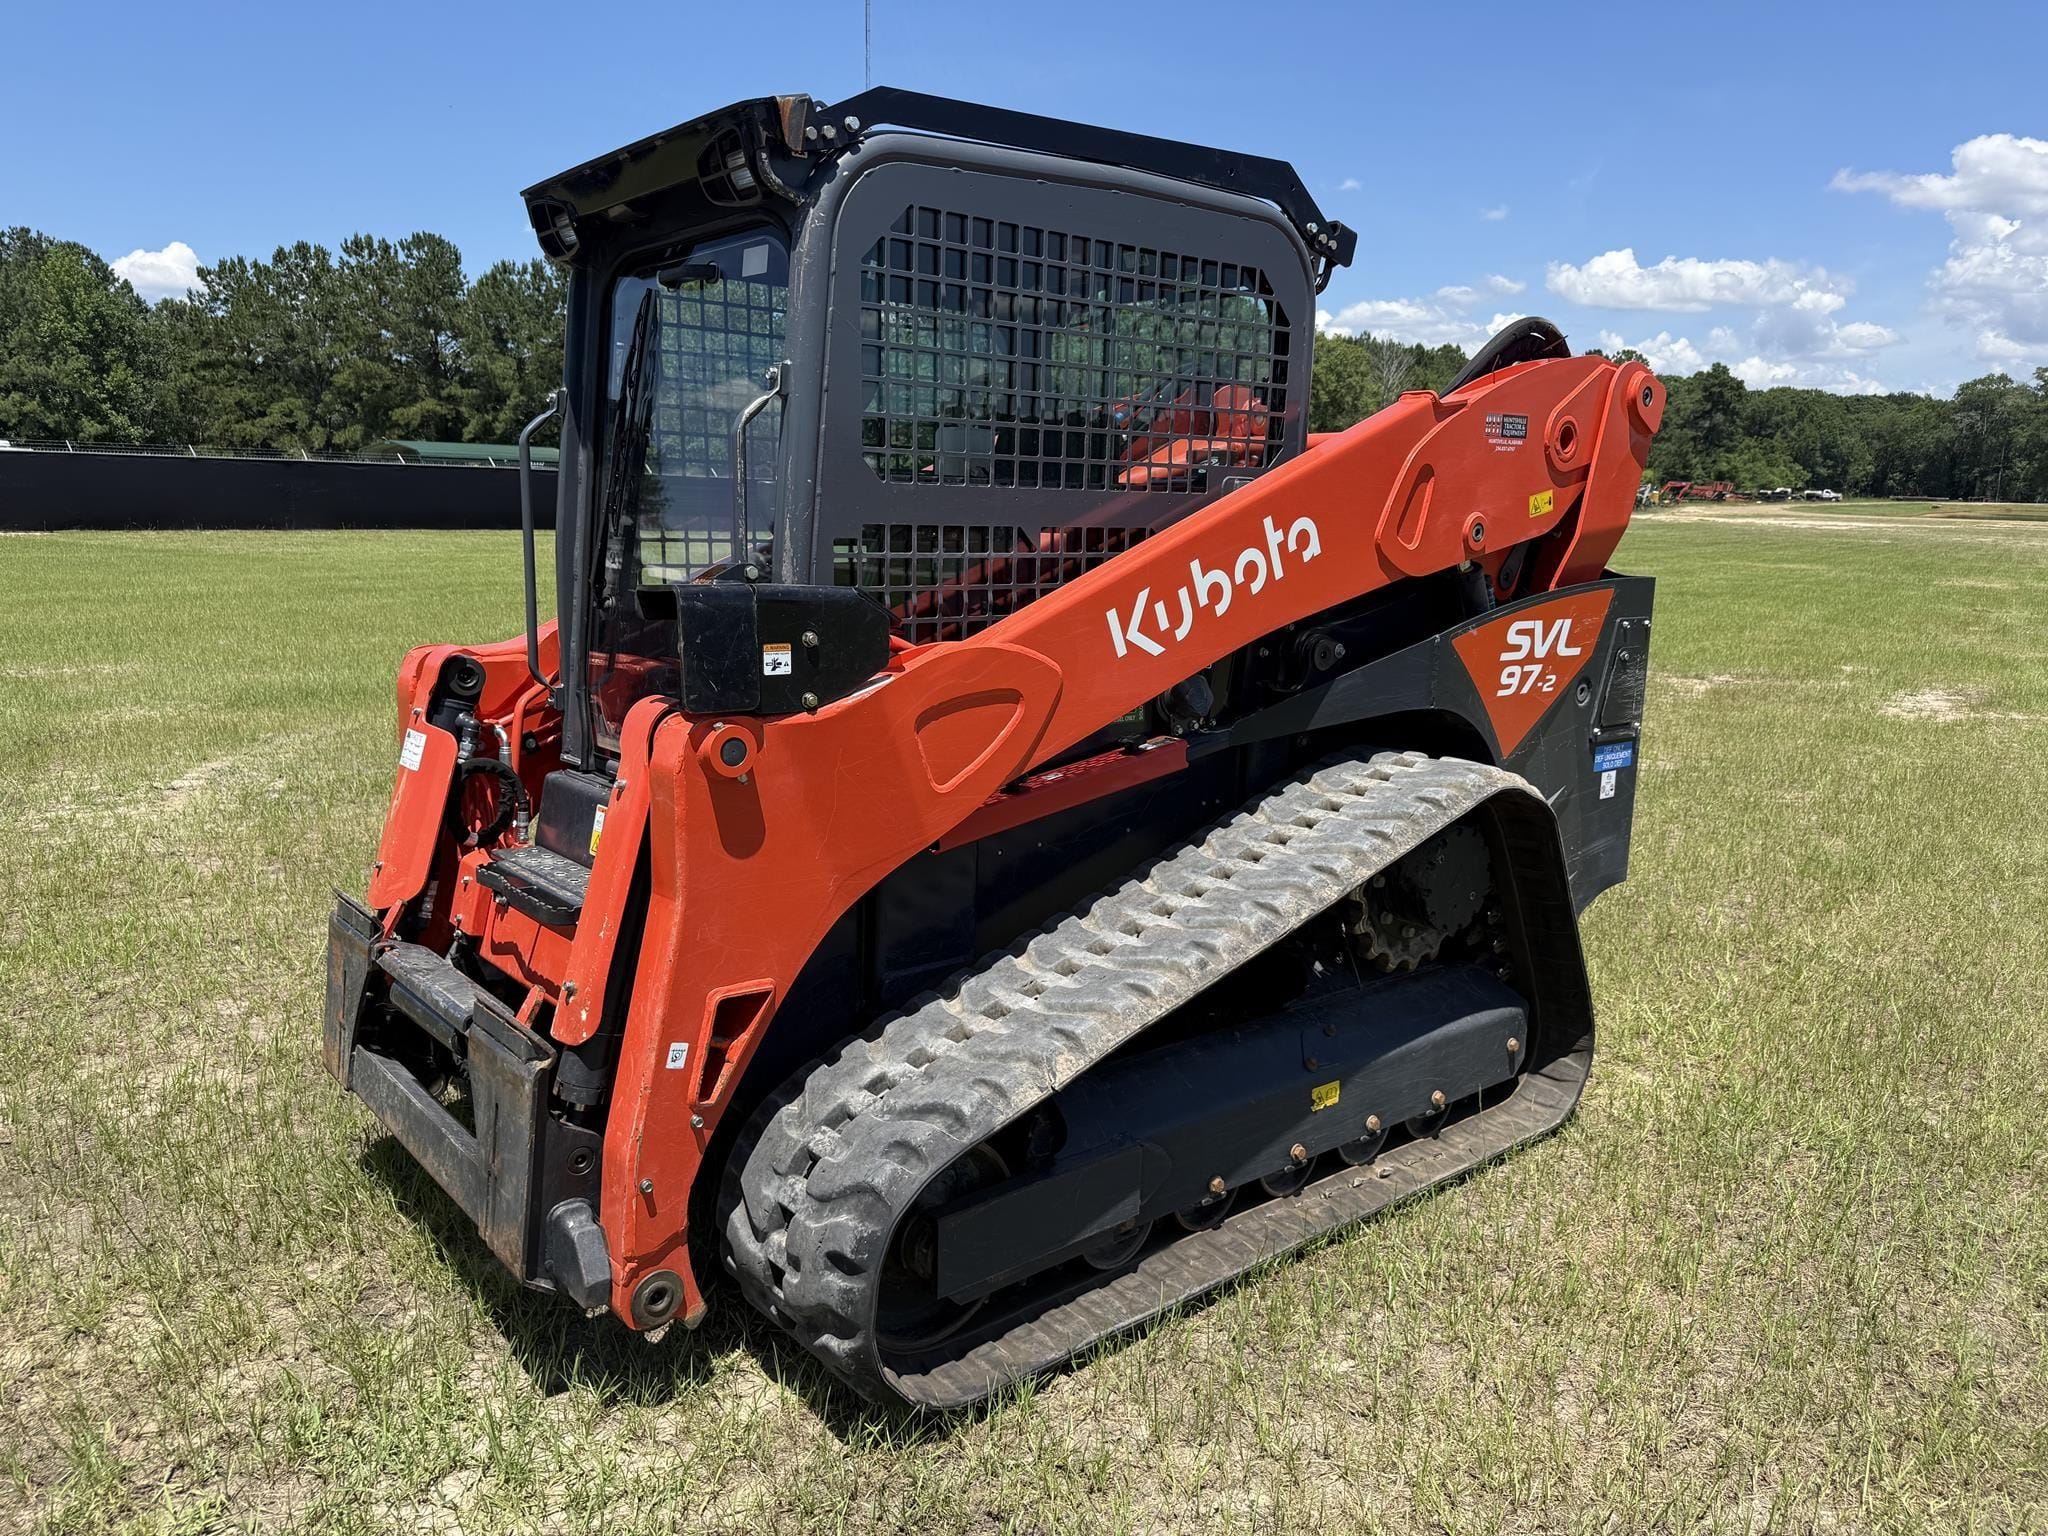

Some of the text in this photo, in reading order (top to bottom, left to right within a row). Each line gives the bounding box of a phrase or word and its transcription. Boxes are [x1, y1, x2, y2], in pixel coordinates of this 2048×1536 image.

[1105, 515, 1322, 658] Kubota
[1499, 618, 1582, 661] SVL
[1496, 663, 1557, 697] 97-2
